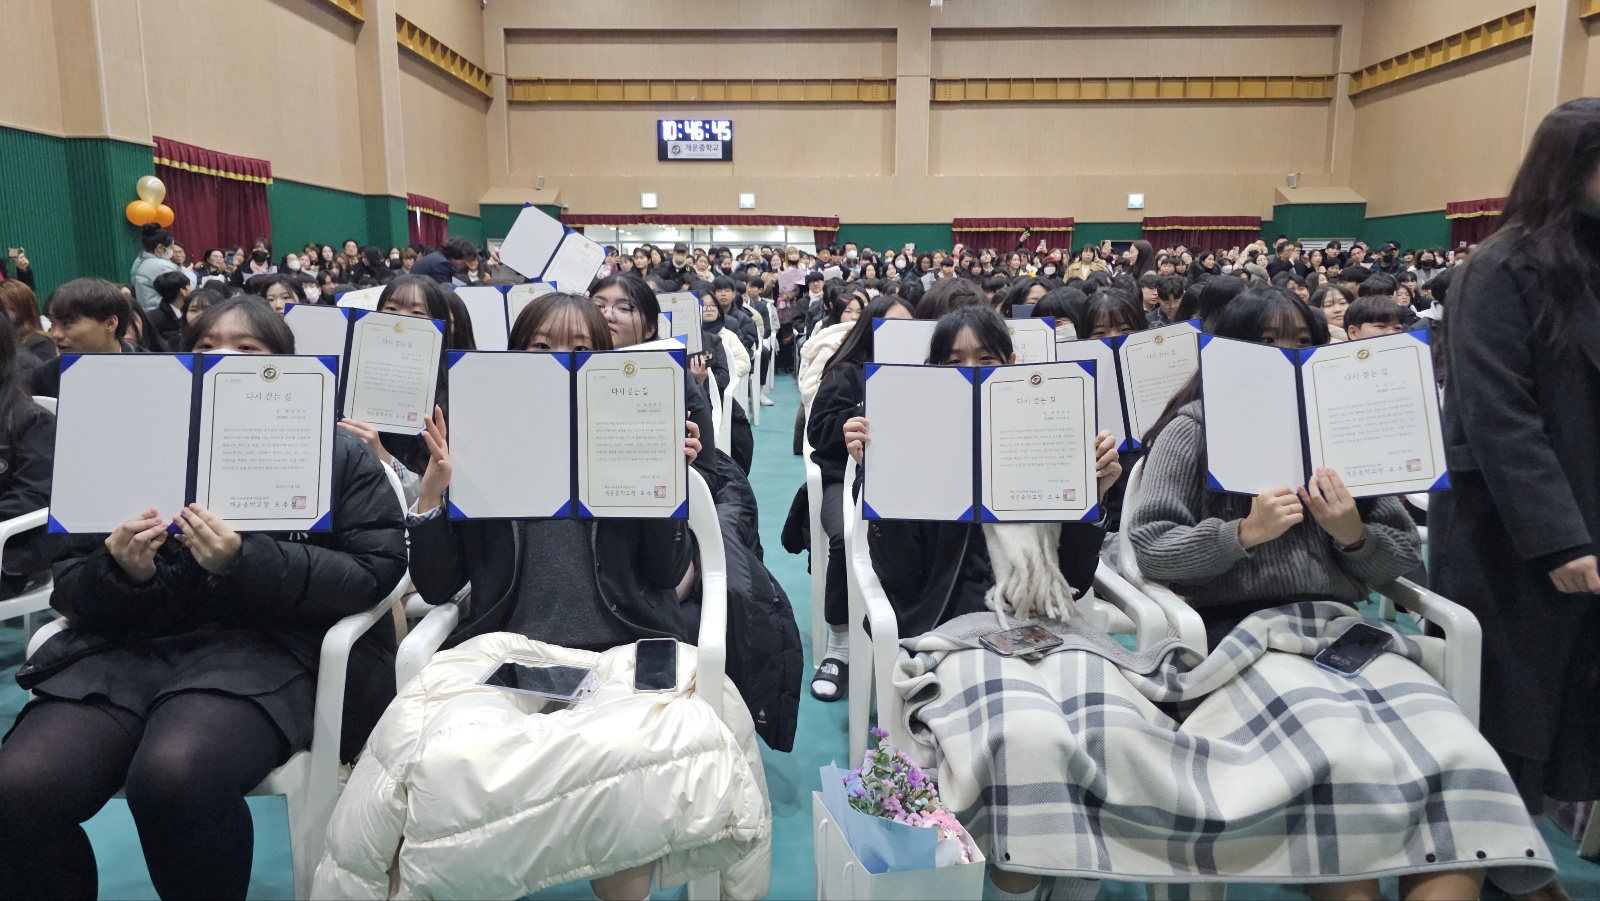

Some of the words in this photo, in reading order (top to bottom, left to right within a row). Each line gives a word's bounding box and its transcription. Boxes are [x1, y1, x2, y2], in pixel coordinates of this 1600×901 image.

[662, 120, 731, 141] 10:46:45
[685, 143, 719, 152] 개운중학교
[1344, 372, 1360, 381] 다시
[246, 391, 262, 401] 다시
[611, 387, 625, 396] 다시
[1016, 397, 1031, 406] 다시
